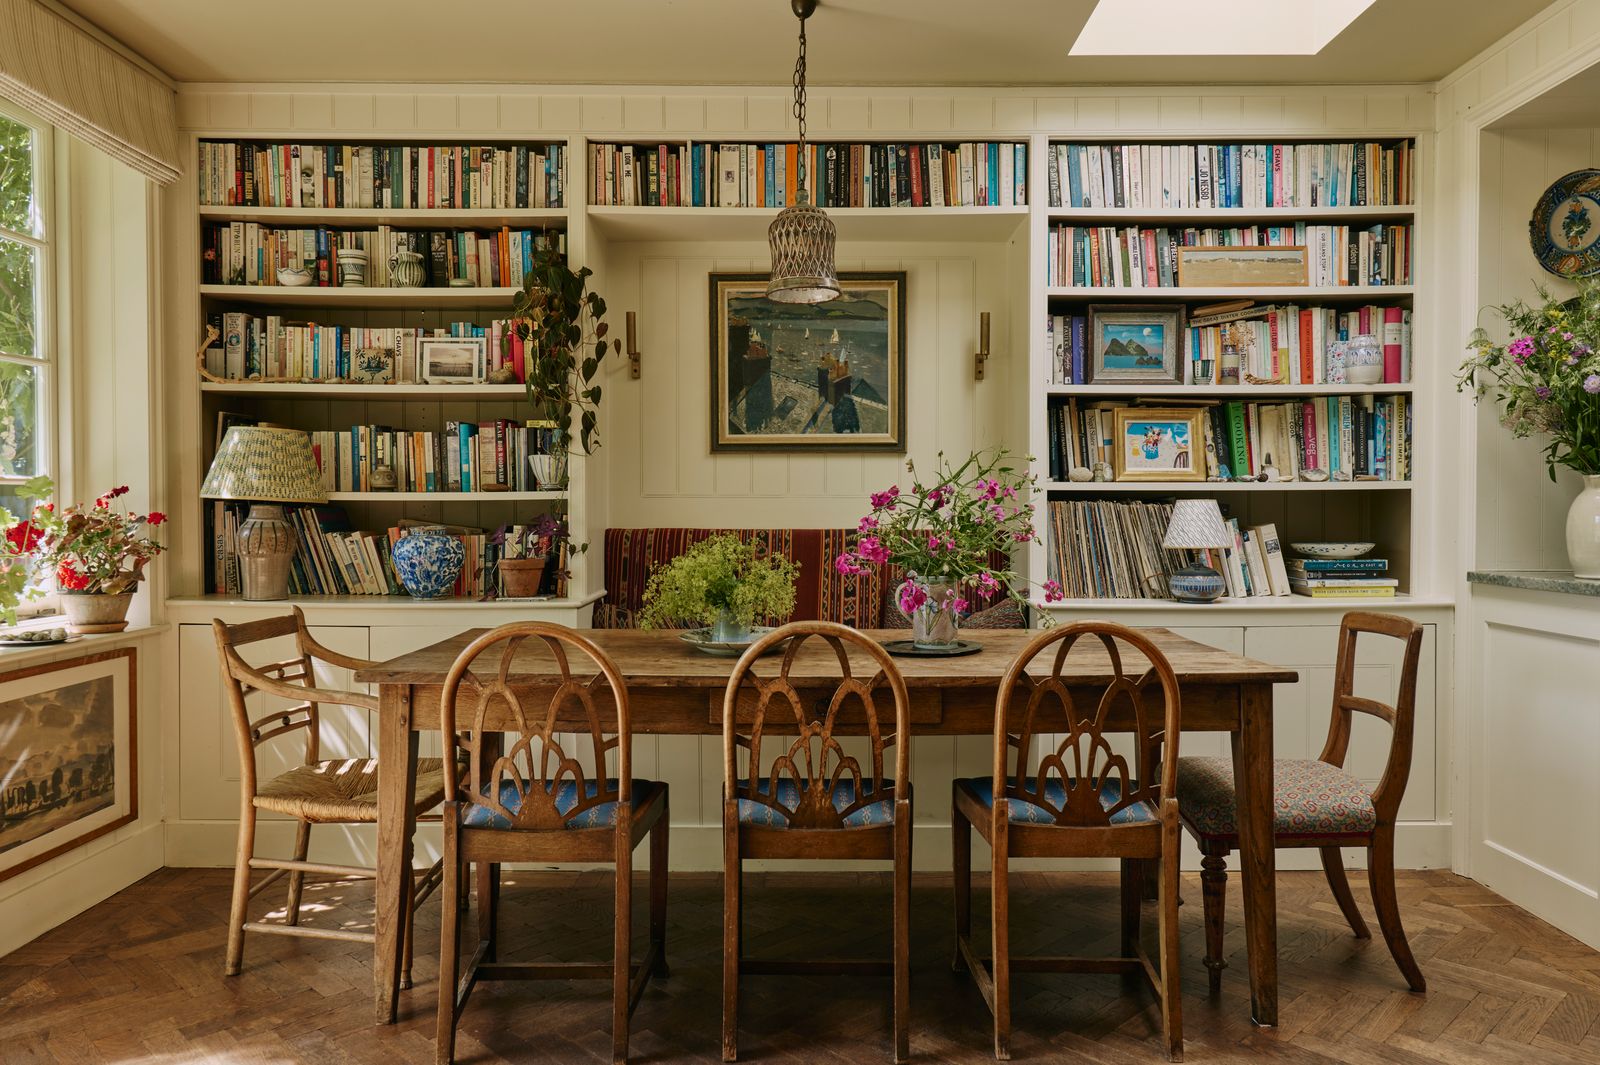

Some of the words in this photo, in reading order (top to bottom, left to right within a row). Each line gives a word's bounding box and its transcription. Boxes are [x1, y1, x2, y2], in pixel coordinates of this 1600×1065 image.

[625, 170, 632, 178] ME
[1050, 168, 1058, 190] SMITH
[1200, 168, 1208, 178] JO
[245, 171, 253, 200] ALAMEIN
[1200, 179, 1209, 201] NESBO
[1087, 415, 1095, 430] Nigel
[1342, 401, 1350, 430] JERUSALEM
[1235, 415, 1246, 465] COOKING
[1306, 437, 1317, 456] veg
